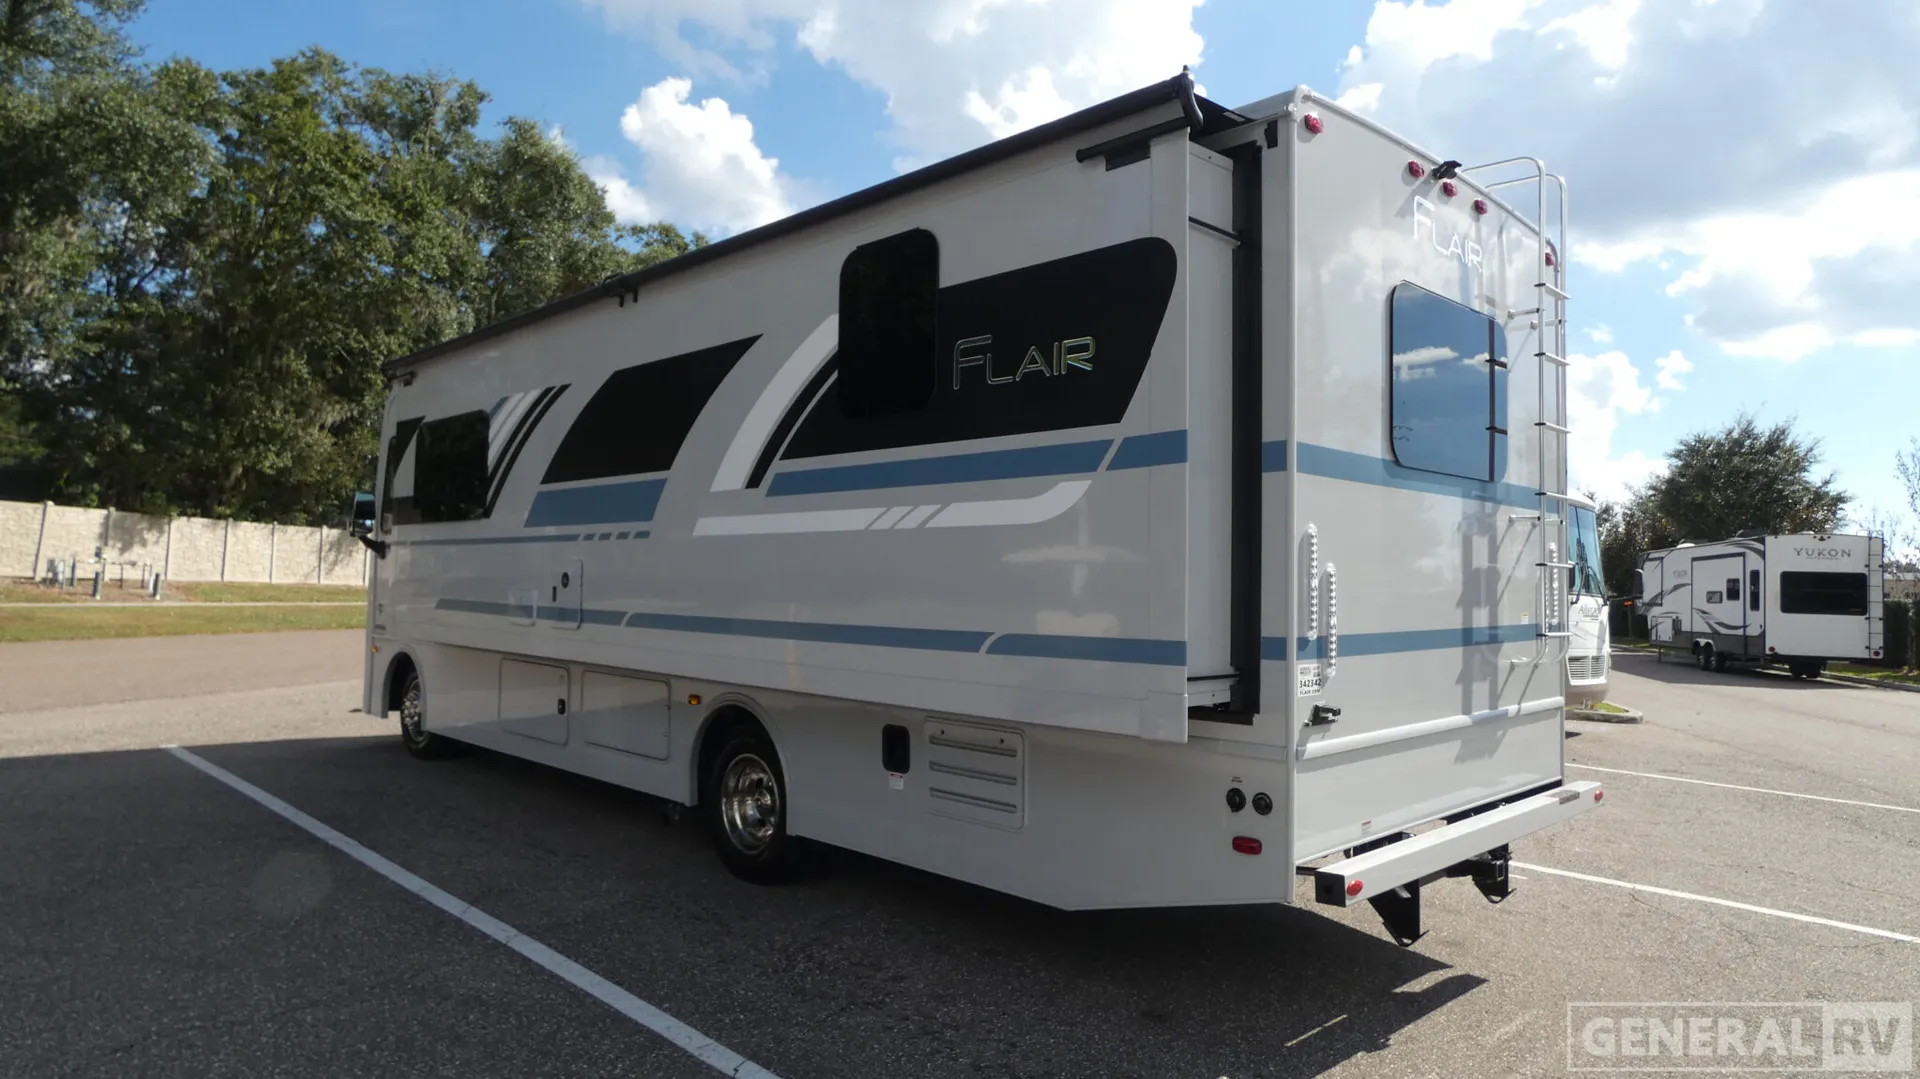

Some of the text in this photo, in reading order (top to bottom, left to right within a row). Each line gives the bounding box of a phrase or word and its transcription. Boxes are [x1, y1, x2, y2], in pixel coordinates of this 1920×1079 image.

[1413, 195, 1483, 272] FLAIR
[953, 334, 1096, 390] FLAIR
[1793, 547, 1851, 557] YUKON
[1299, 679, 1322, 688] 342342
